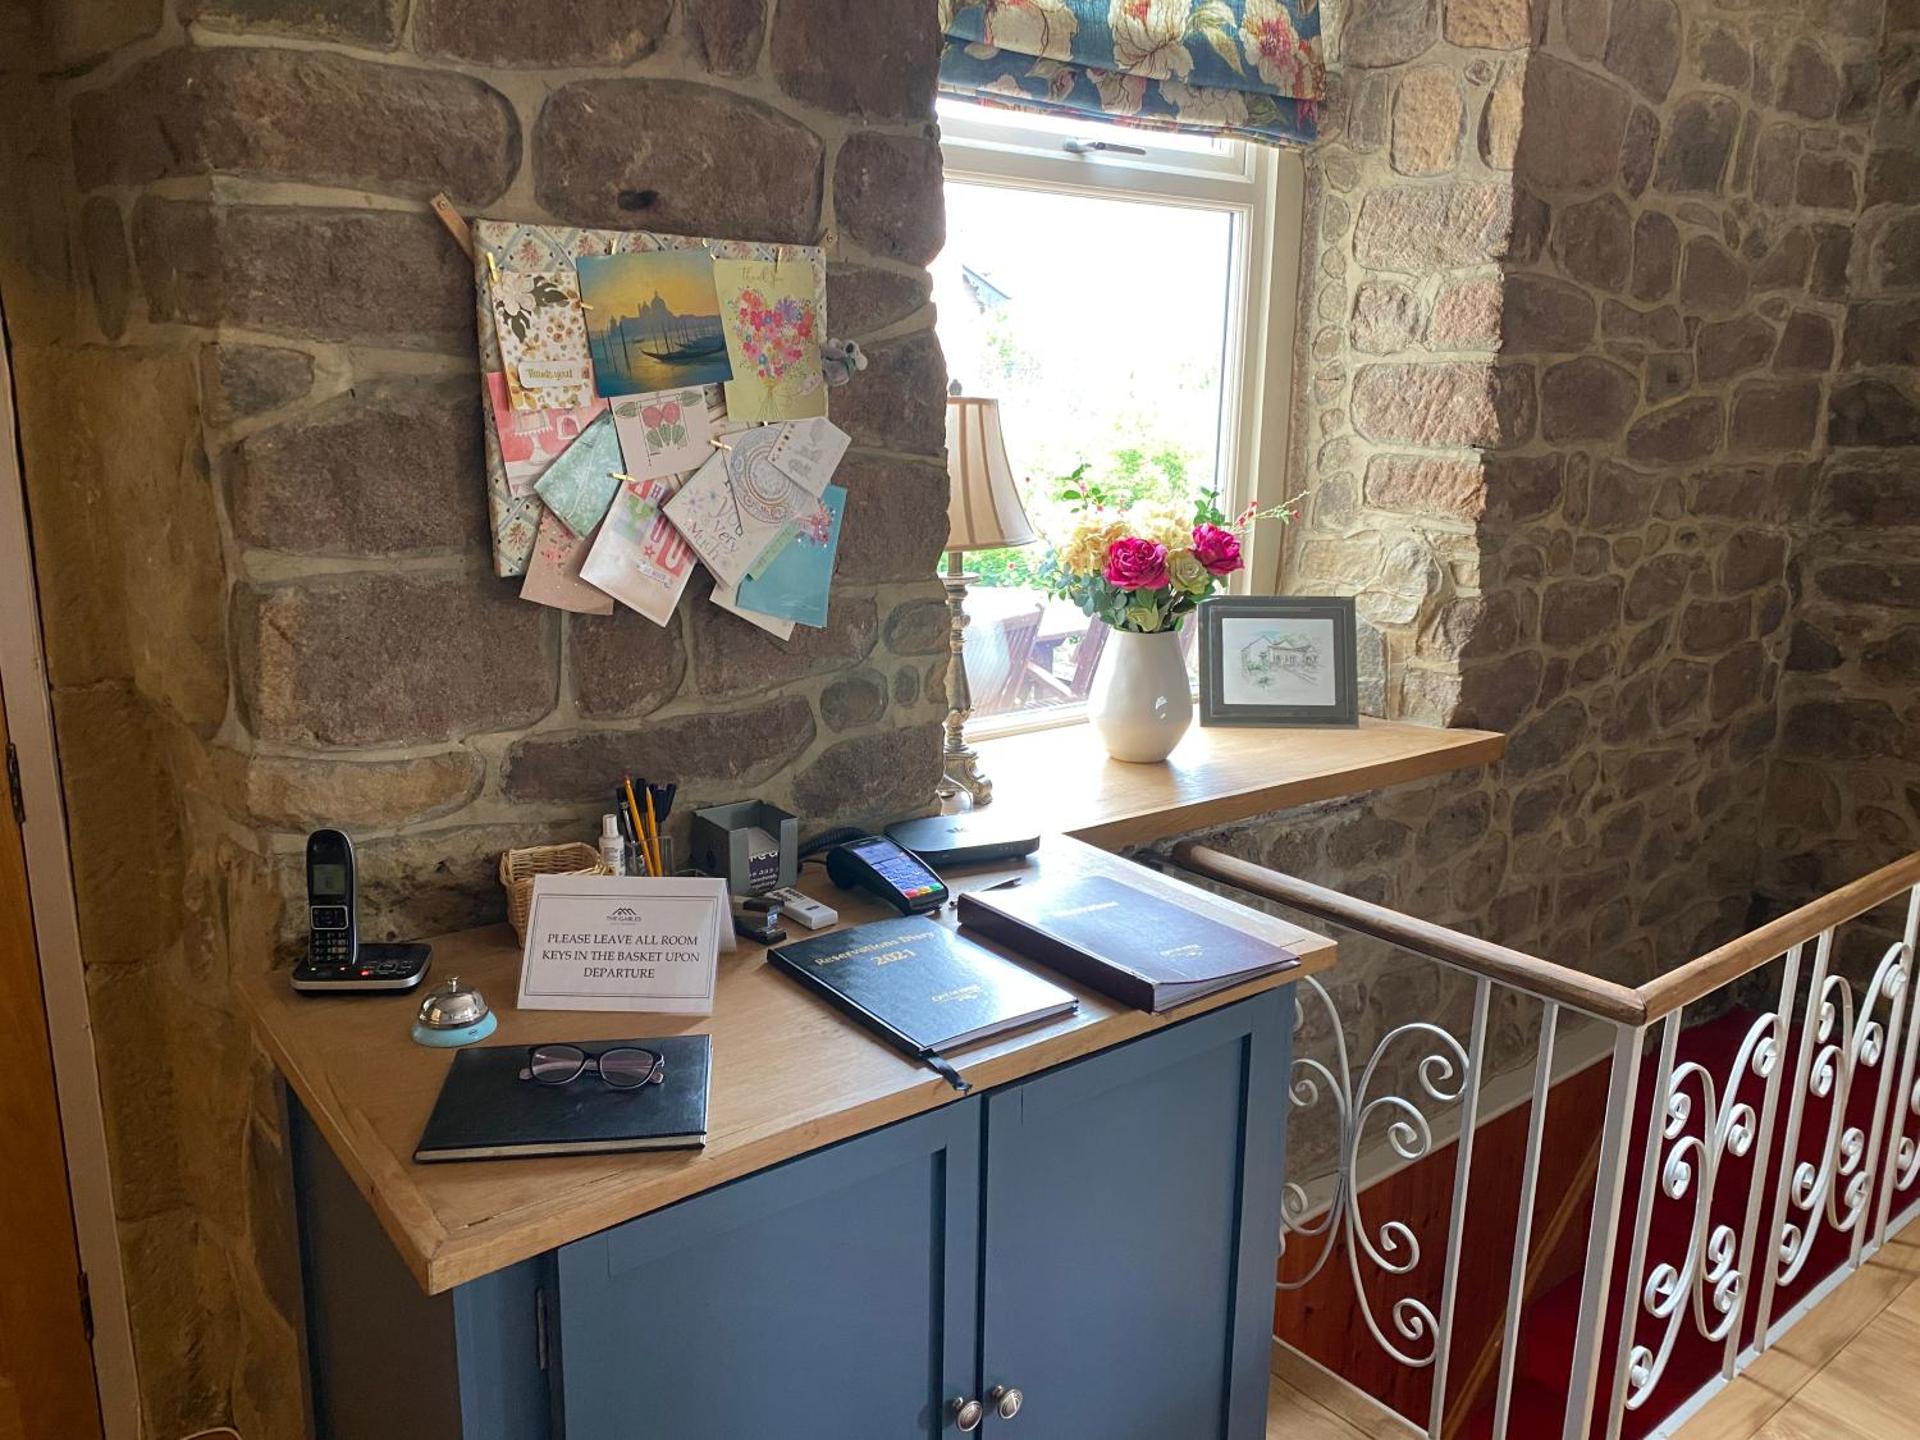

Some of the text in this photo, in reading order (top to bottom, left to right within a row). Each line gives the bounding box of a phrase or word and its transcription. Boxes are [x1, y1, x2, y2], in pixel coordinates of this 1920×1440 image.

[547, 933, 698, 946] PLEASE LEAVE ALL ROOM
[542, 950, 701, 962] KEYS IN THE BASKET UPON
[814, 939, 899, 967] Reservations
[871, 949, 917, 967] 2021
[583, 967, 656, 979] DEPARTURE
